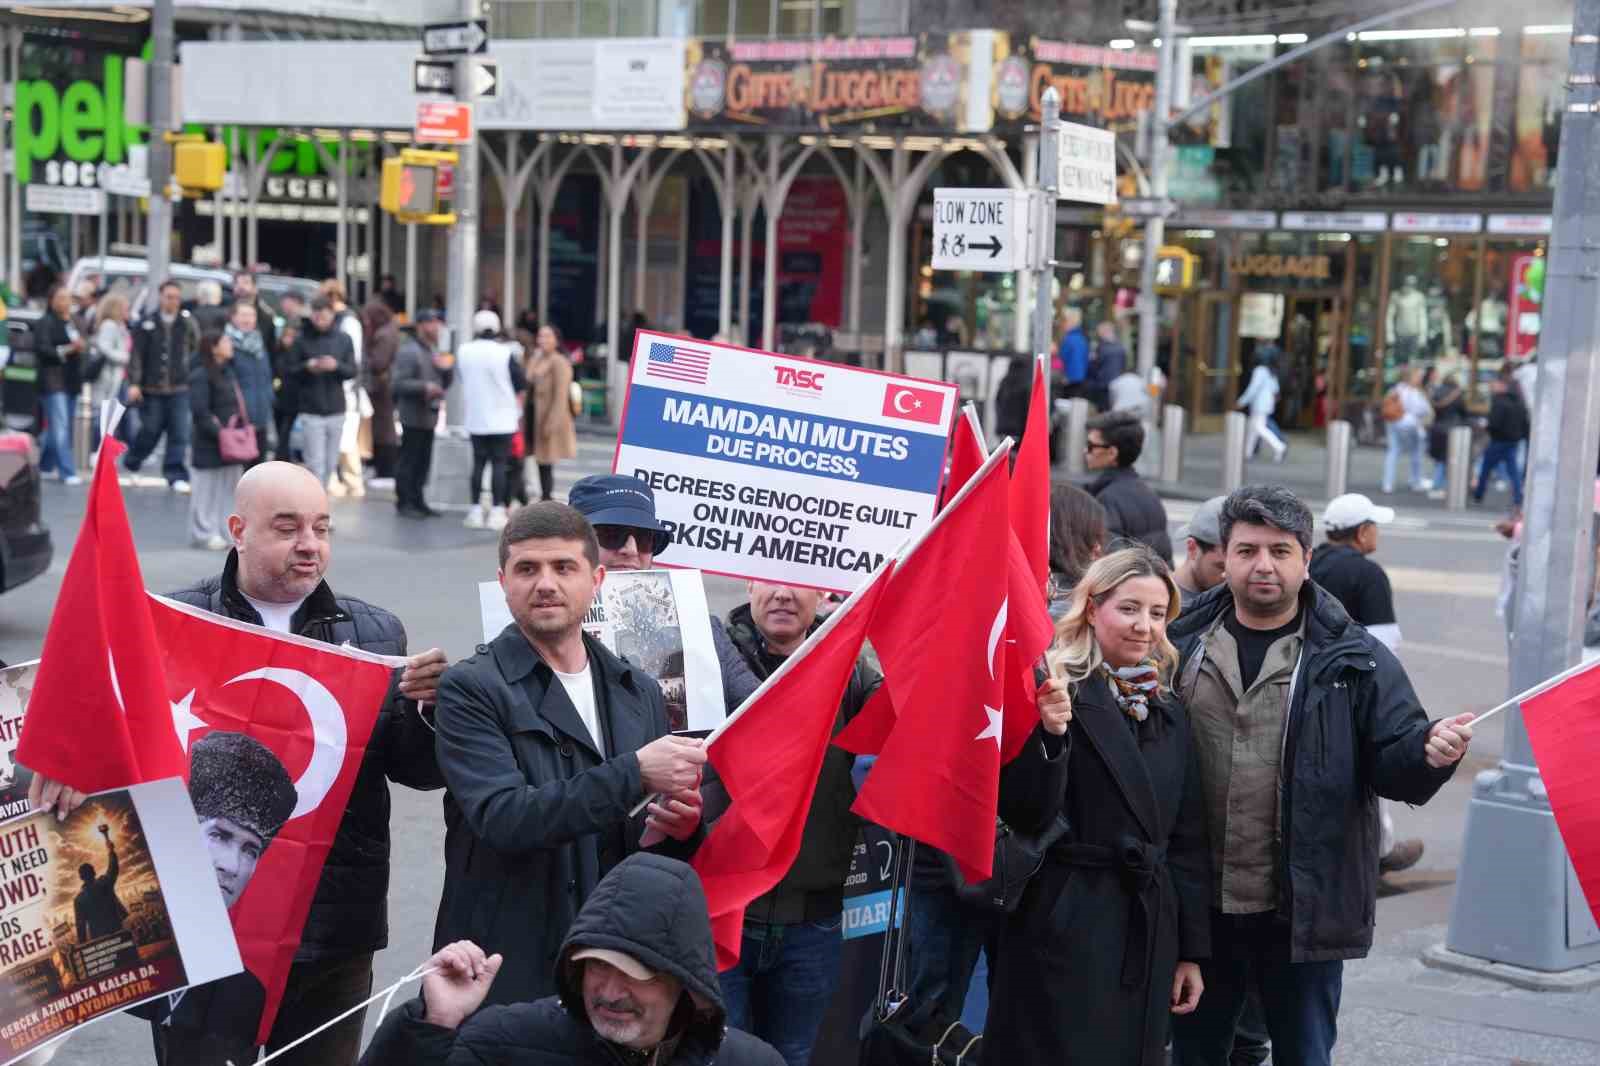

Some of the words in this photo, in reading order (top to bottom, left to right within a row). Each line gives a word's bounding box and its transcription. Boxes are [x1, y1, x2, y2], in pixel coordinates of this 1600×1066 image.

[969, 201, 1004, 225] ZONE
[774, 365, 825, 391] TASC
[662, 397, 809, 444] MAMDANI
[810, 423, 910, 461] MUTES
[706, 434, 754, 460] DUE
[755, 442, 860, 480] PROCESS,
[633, 468, 736, 502] DECREES
[738, 486, 854, 521] GENOCIDE
[855, 505, 918, 530] GUILT
[656, 519, 744, 554] RKISH
[693, 503, 729, 524] ON
[730, 508, 850, 543] INNOCENT
[11, 848, 48, 876] NEED
[1, 928, 52, 966] RAGE.
[98, 970, 137, 993] KALSA
